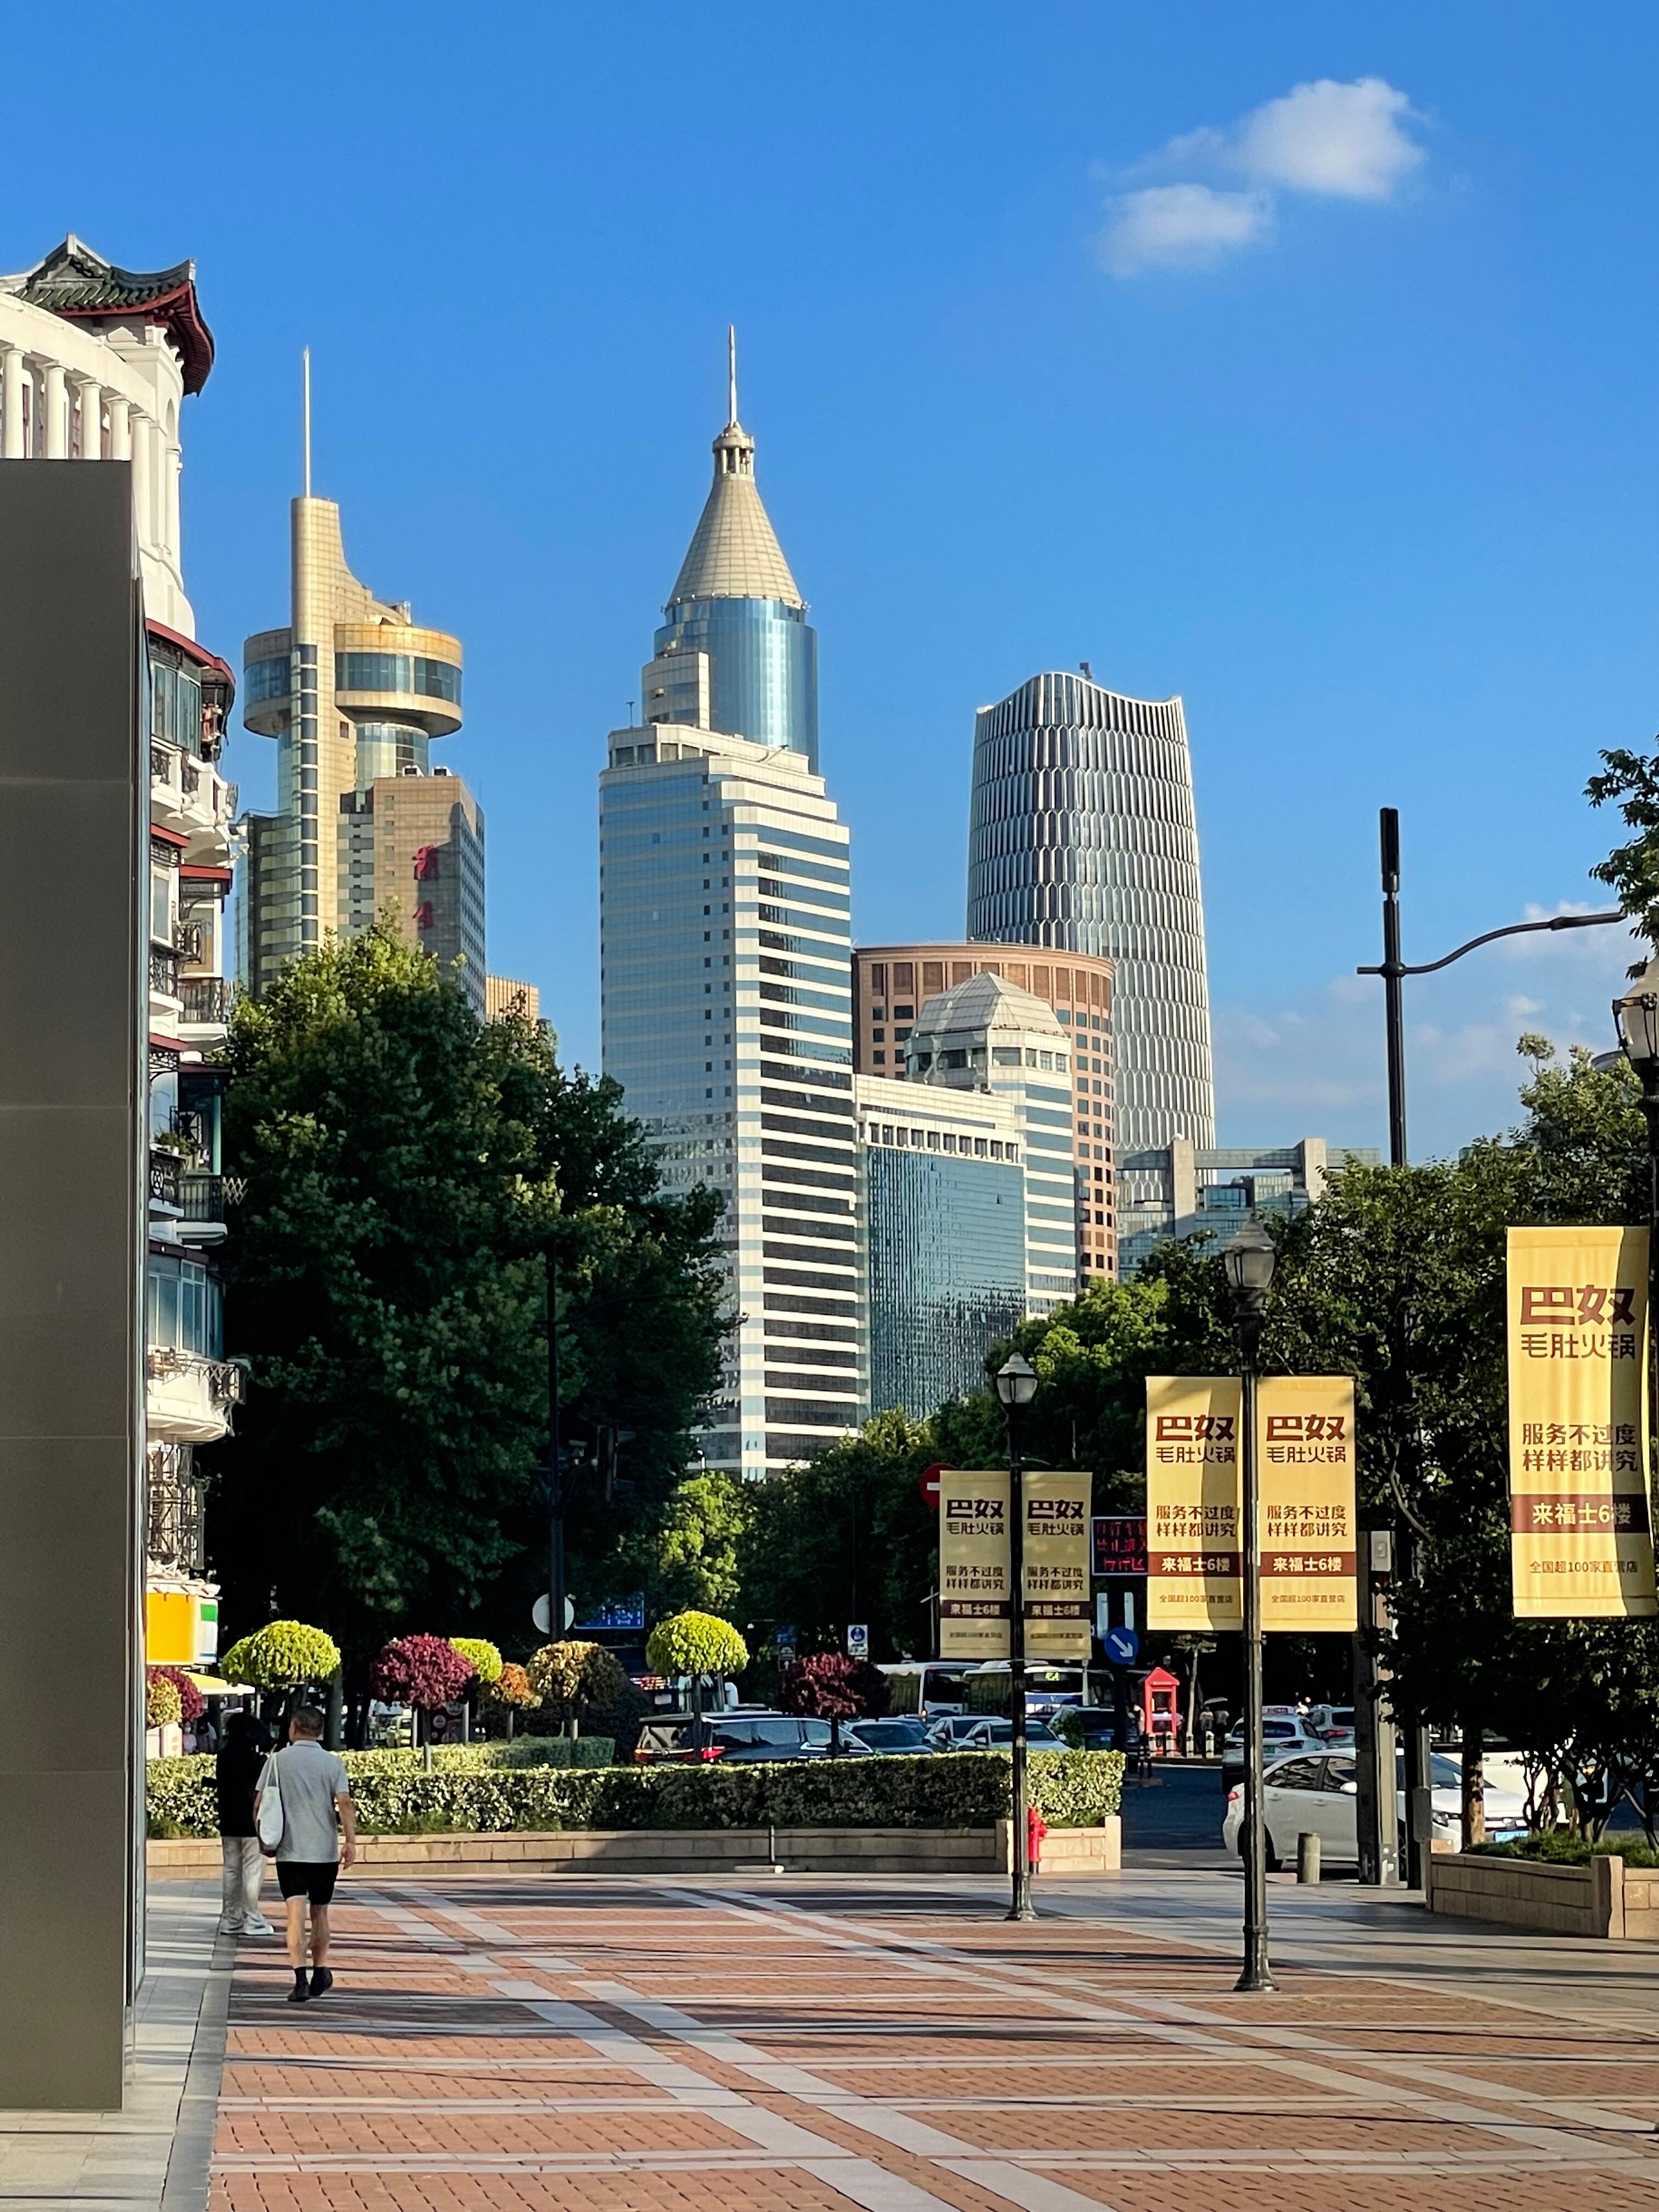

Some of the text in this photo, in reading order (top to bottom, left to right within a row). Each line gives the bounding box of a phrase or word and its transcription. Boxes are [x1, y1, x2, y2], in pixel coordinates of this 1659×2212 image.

[1520, 1284, 1636, 1325] 巴奴
[1521, 1333, 1636, 1359] 毛肚火锅
[1155, 1414, 1234, 1441] 巴奴
[1266, 1414, 1345, 1441] 巴奴
[1522, 1423, 1637, 1446] 服务不过度
[1156, 1446, 1235, 1463] 毛肚火锅
[1267, 1446, 1346, 1463] 毛肚火锅
[1522, 1449, 1638, 1472] 样样都讲究
[946, 1499, 1004, 1519] 巴奴
[1027, 1499, 1084, 1519] 巴奴
[1156, 1505, 1235, 1520] 服务不过度
[1267, 1505, 1346, 1520] 服务不过度
[1532, 1503, 1631, 1525] 来福士6楼
[946, 1522, 1004, 1535] 毛肚火锅
[1028, 1522, 1084, 1536] 毛肚火锅
[1156, 1522, 1237, 1537] 样样都讲究
[1268, 1522, 1347, 1537] 样样都讲究
[1161, 1557, 1230, 1572] 来福士6楼
[1273, 1557, 1342, 1572] 来福士6楼
